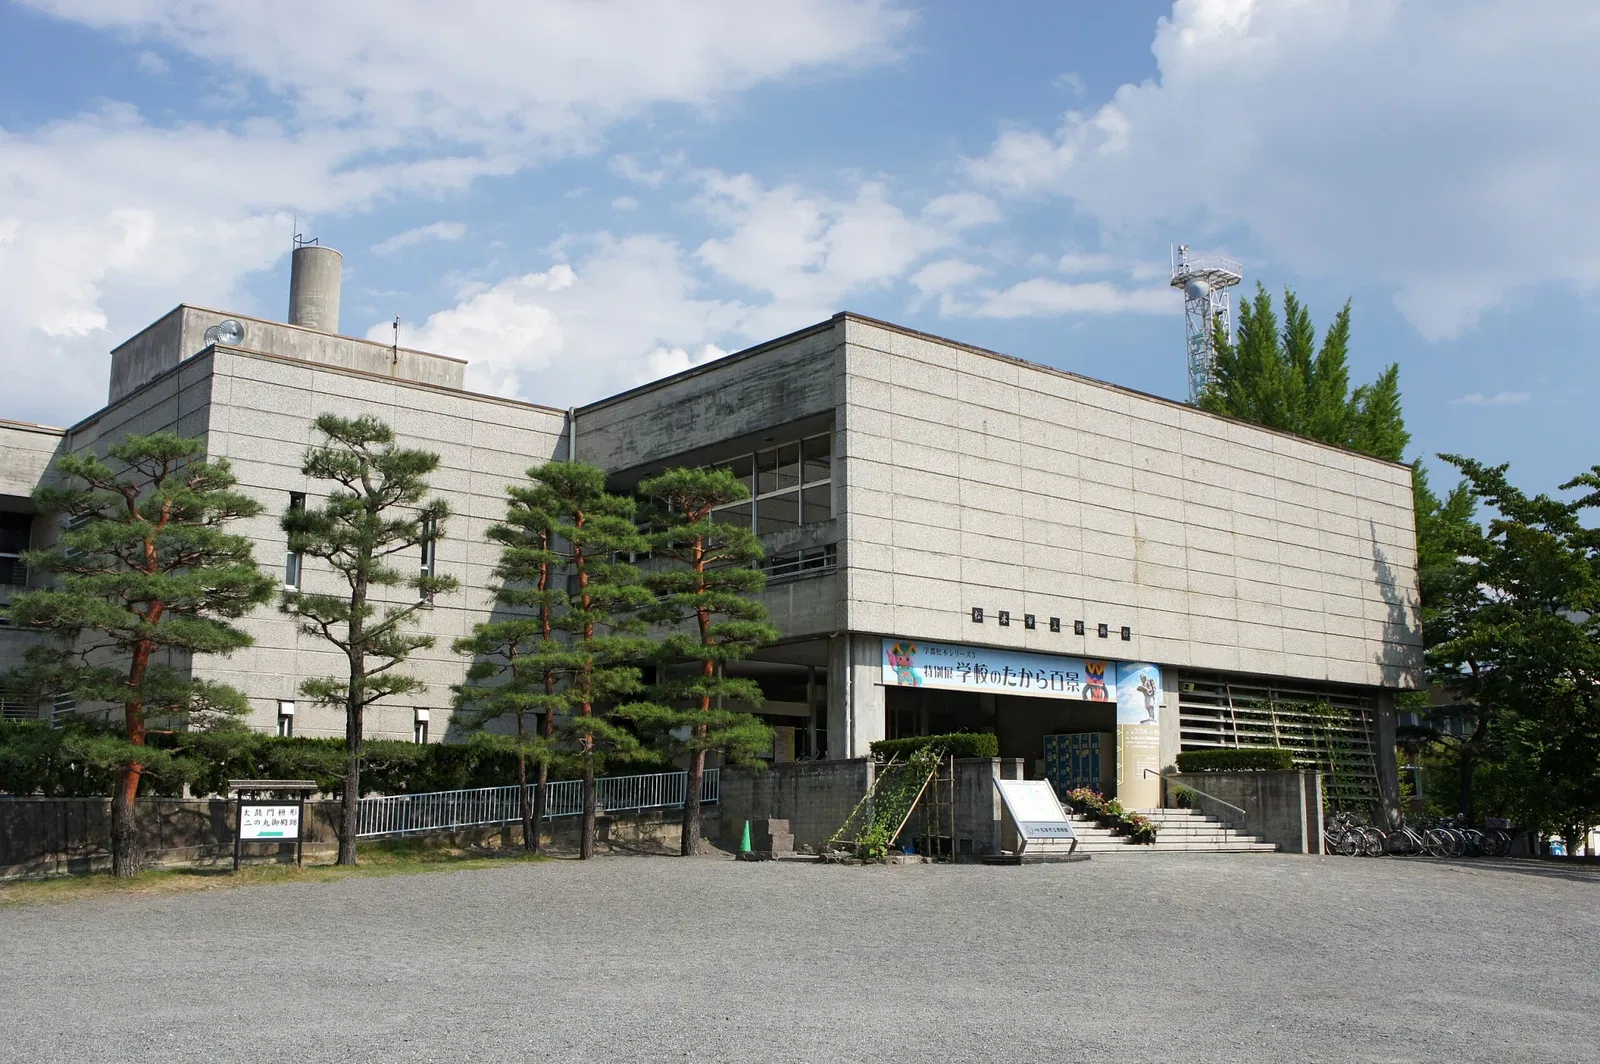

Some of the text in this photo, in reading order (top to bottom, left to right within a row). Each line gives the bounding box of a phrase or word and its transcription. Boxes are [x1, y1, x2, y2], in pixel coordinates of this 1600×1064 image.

[973, 609, 1129, 640] 松本市立博物館
[923, 661, 1080, 692] 特別展 学校のたから百景
[243, 818, 298, 827] 二の丸御殿跡
